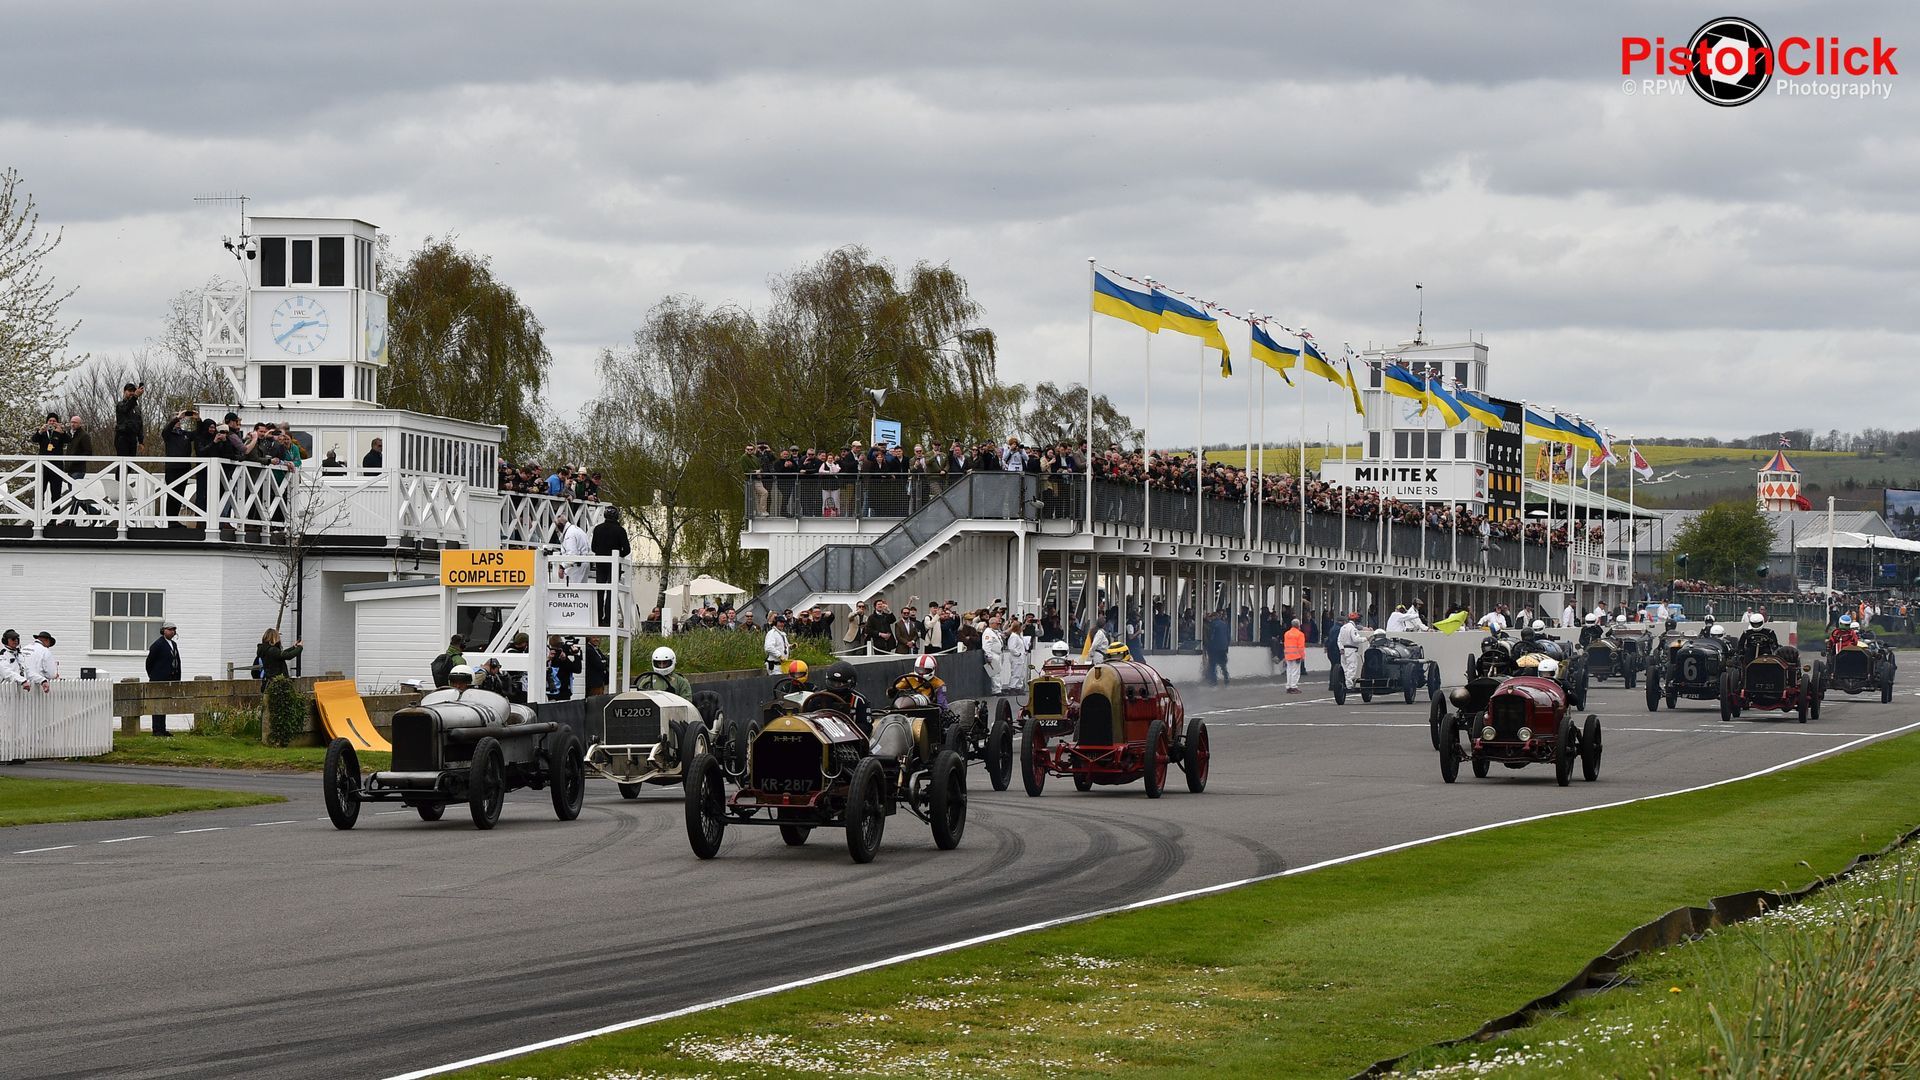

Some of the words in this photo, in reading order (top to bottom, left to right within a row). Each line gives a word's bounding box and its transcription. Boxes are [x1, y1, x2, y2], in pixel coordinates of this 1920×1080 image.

[1355, 467, 1438, 482] MINTEX
[1142, 542, 1150, 553] 2
[1169, 545, 1177, 556] 3
[1194, 548, 1202, 558] 4
[1219, 550, 1227, 560] 5
[1243, 552, 1250, 562] 6
[471, 552, 504, 566] LAPS
[1276, 555, 1284, 565] 7
[1298, 557, 1306, 567] 8
[1320, 559, 1327, 569] 9
[1334, 561, 1346, 571] 10
[1355, 564, 1365, 573] 11
[1372, 565, 1383, 575] 12
[448, 570, 526, 583] COMPLETED
[1397, 568, 1409, 577] 14
[1415, 570, 1426, 578] 15
[1431, 571, 1442, 580] 16
[1446, 572, 1457, 581] 17
[1462, 574, 1472, 583] 18
[1476, 575, 1486, 584] 19
[1501, 577, 1512, 586] 20
[1516, 579, 1525, 588] 21
[1527, 580, 1538, 589] 22
[1541, 581, 1551, 590] 23
[1551, 582, 1561, 591] 24
[1563, 584, 1573, 592] 25
[548, 601, 589, 609] FORMATION
[1683, 657, 1698, 681] 6
[761, 778, 813, 792] KR-2817
